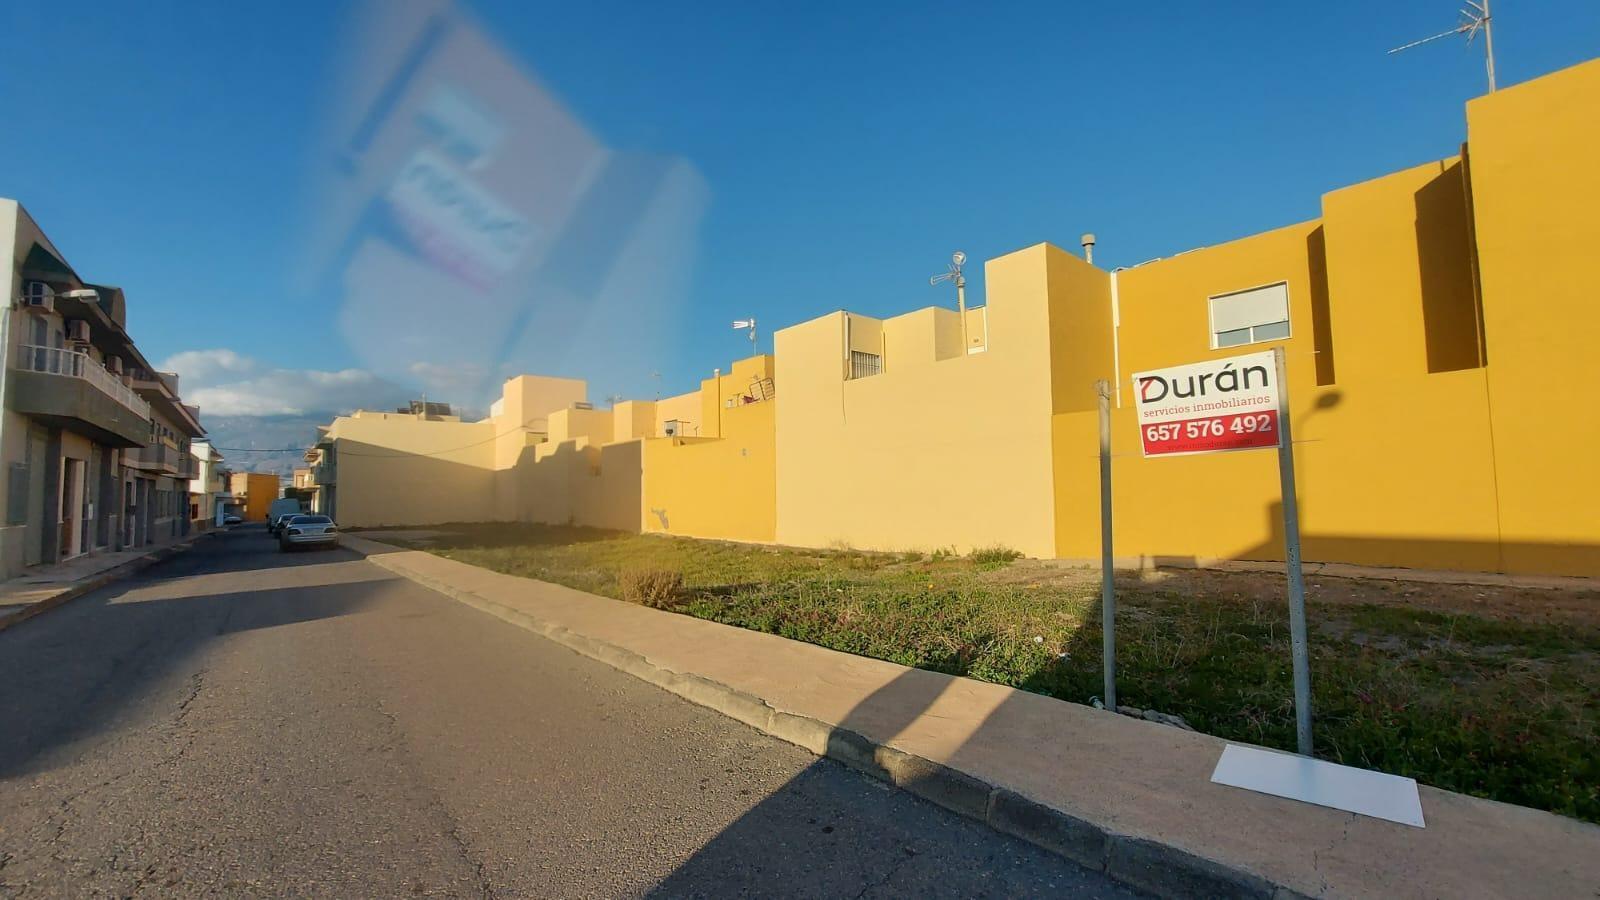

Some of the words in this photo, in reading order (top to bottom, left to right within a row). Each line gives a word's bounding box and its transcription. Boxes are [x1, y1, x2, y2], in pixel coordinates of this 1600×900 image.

[1139, 362, 1269, 404] Durán
[1143, 405, 1190, 418] servicios
[1193, 395, 1271, 412] inmobiliarios
[1146, 423, 1181, 442] 657
[1186, 419, 1224, 439] 576
[1230, 414, 1272, 434] 492
